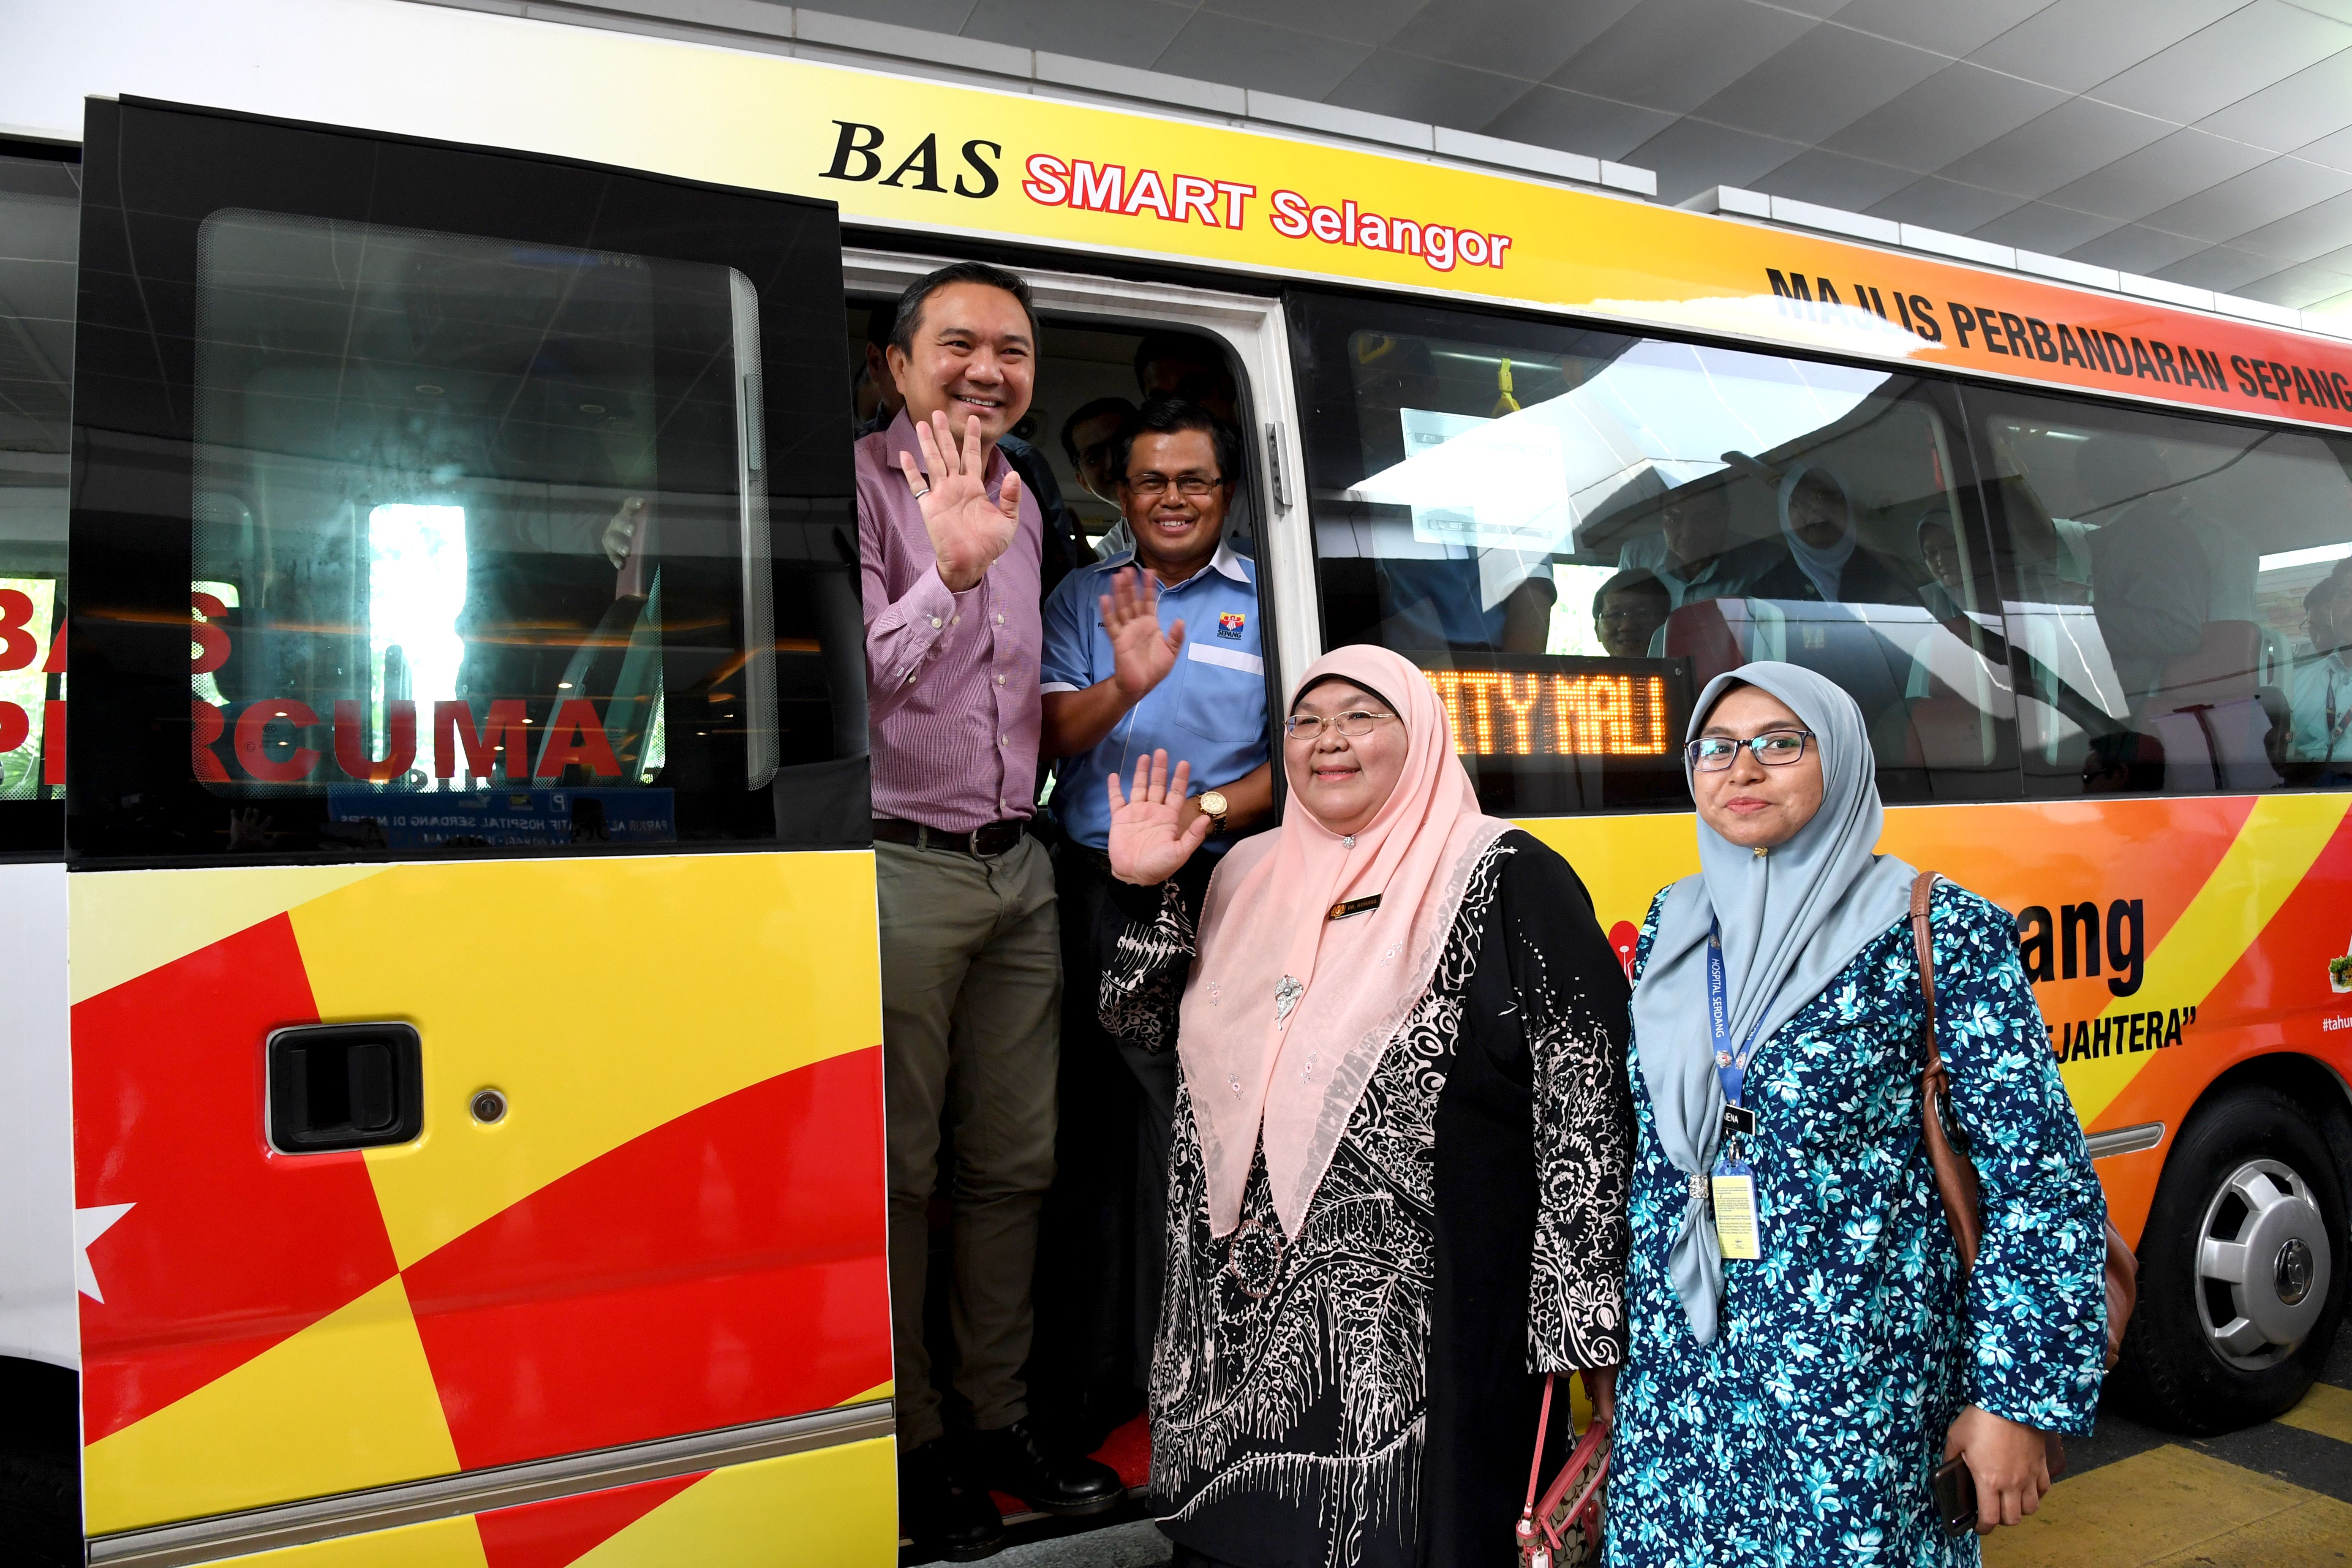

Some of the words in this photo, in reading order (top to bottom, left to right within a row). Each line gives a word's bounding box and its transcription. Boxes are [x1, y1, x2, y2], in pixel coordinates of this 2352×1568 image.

[819, 120, 1001, 198] BAS
[1022, 153, 1256, 230] SMART
[1269, 189, 1512, 272] Selangor
[1765, 268, 1942, 342] MAJLIS
[1946, 301, 2229, 392] PERBANDARAN
[2230, 355, 2352, 412] SEPANG
[1218, 630, 1241, 638] SEPANG
[1712, 958, 1721, 996] HOSPITAL
[1713, 997, 1725, 1038] SERDANG
[2046, 1006, 2196, 1064] JAHTERA”
